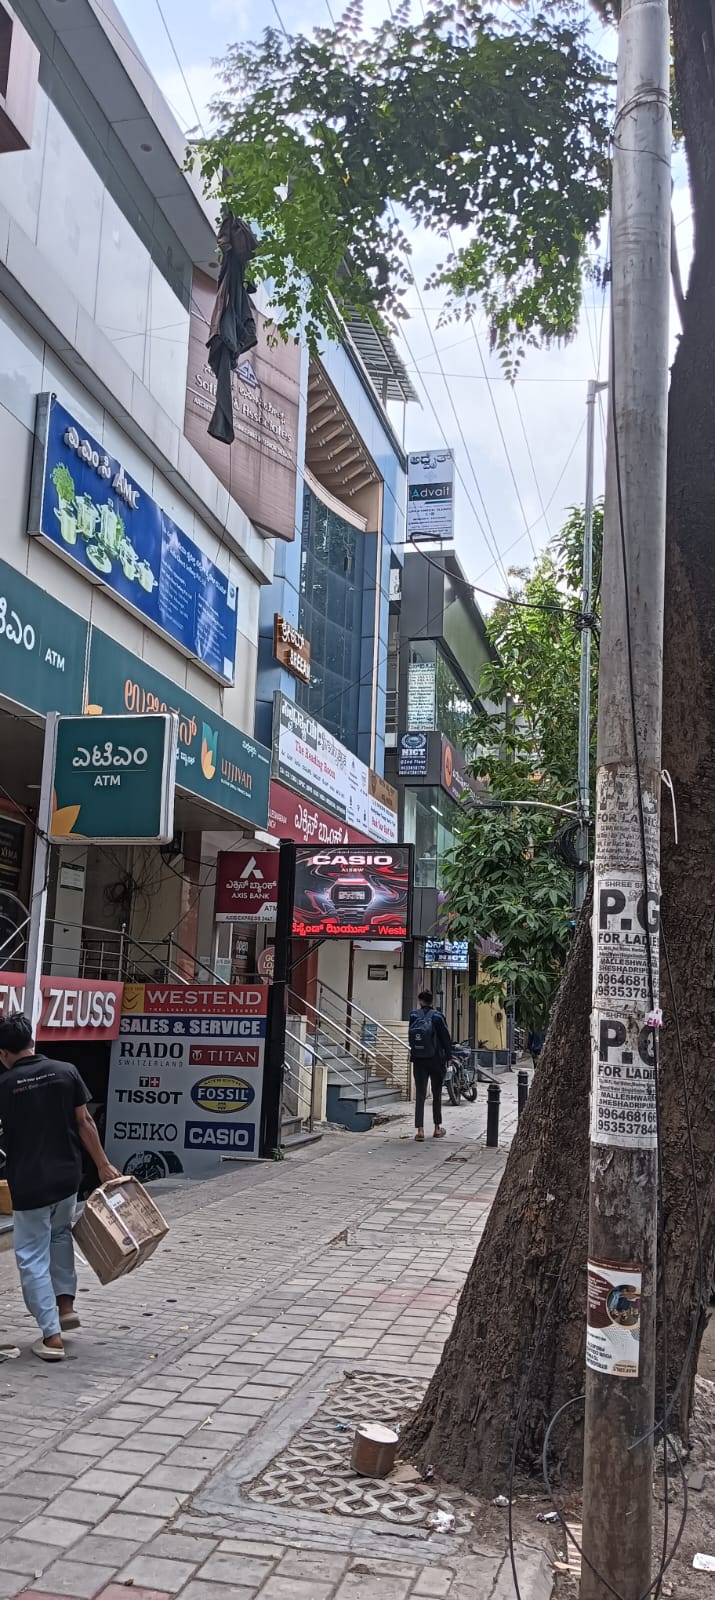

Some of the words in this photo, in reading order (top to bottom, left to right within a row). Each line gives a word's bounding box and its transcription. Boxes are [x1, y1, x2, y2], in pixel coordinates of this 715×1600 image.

[112, 465, 140, 509] AMC
[412, 486, 450, 499] Advait
[44, 647, 65, 672] ATM
[72, 742, 148, 767] ಎಟಿಎಂ
[93, 775, 121, 787] ATM
[313, 855, 393, 866] CASIO
[598, 933, 620, 943] FOR
[146, 990, 262, 1005] WESTEND
[47, 988, 117, 1028] ZEUSS
[120, 1018, 170, 1033] SALES
[173, 1021, 186, 1034] &
[189, 1019, 260, 1035] SERVICE
[119, 1042, 184, 1059] RADO
[207, 1050, 257, 1062] TITAN
[118, 1059, 183, 1068] SWITZERLAND
[598, 1065, 621, 1077] FOR
[115, 1089, 183, 1105] TISSOT
[197, 1087, 249, 1101] FOSSIL
[114, 1121, 178, 1142] SEIKO
[189, 1127, 249, 1146] CASIO
